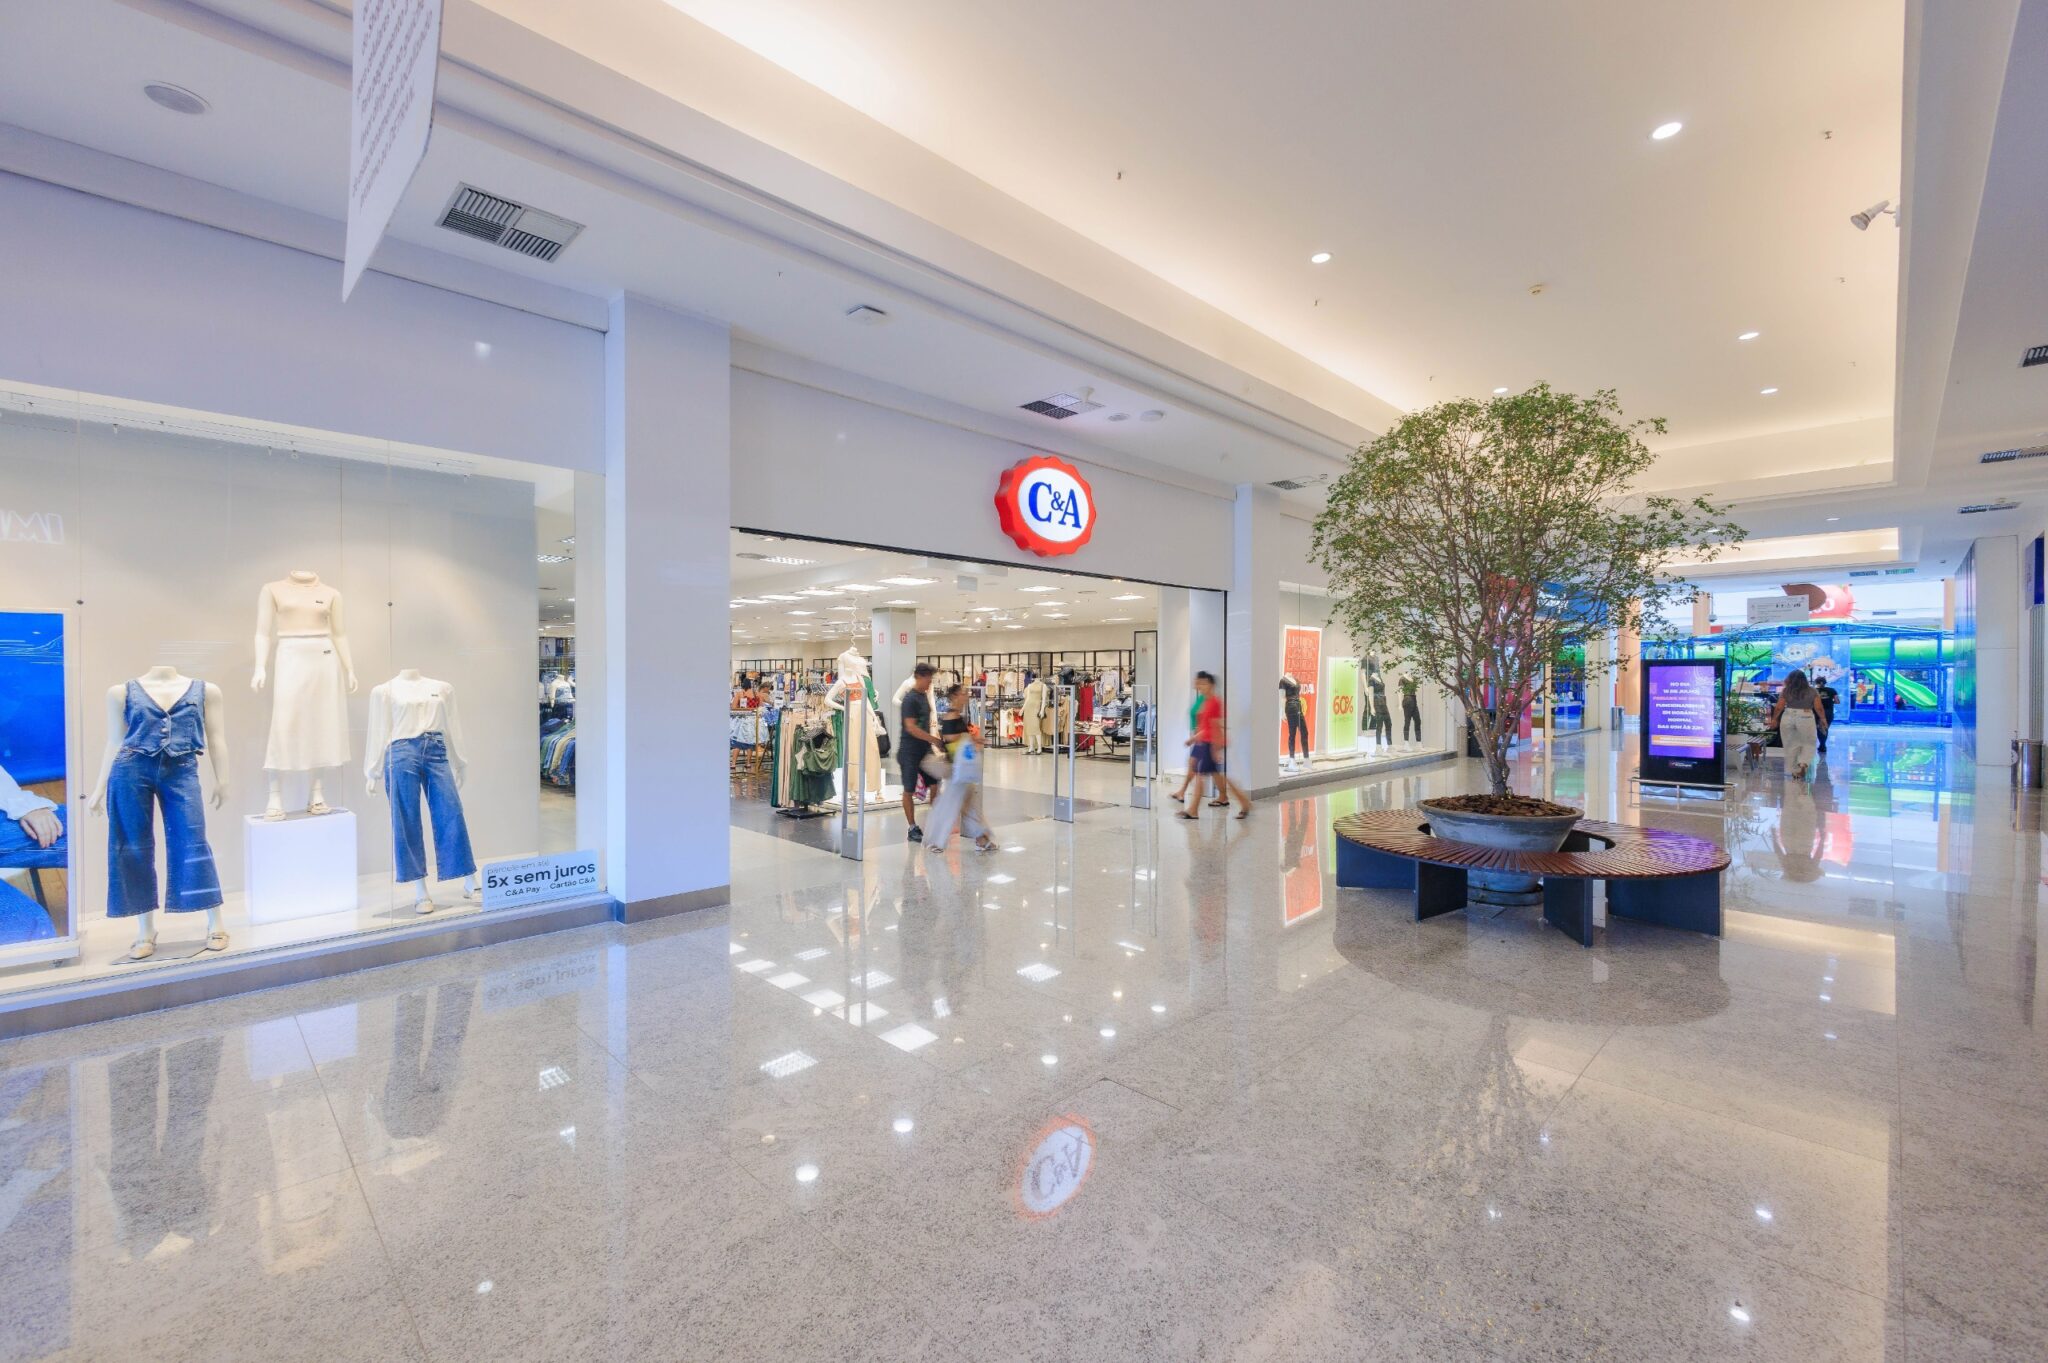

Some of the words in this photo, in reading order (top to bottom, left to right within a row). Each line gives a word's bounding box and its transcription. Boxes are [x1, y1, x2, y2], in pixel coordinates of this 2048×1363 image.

[1028, 481, 1082, 529] C&A
[1333, 695, 1354, 715] 60%
[487, 874, 509, 889] 5x
[514, 869, 551, 885] sem
[554, 862, 596, 882] juros
[505, 887, 525, 897] C&A
[526, 885, 541, 894] Pay
[549, 879, 577, 890] Cartão
[578, 876, 596, 886] C&A
